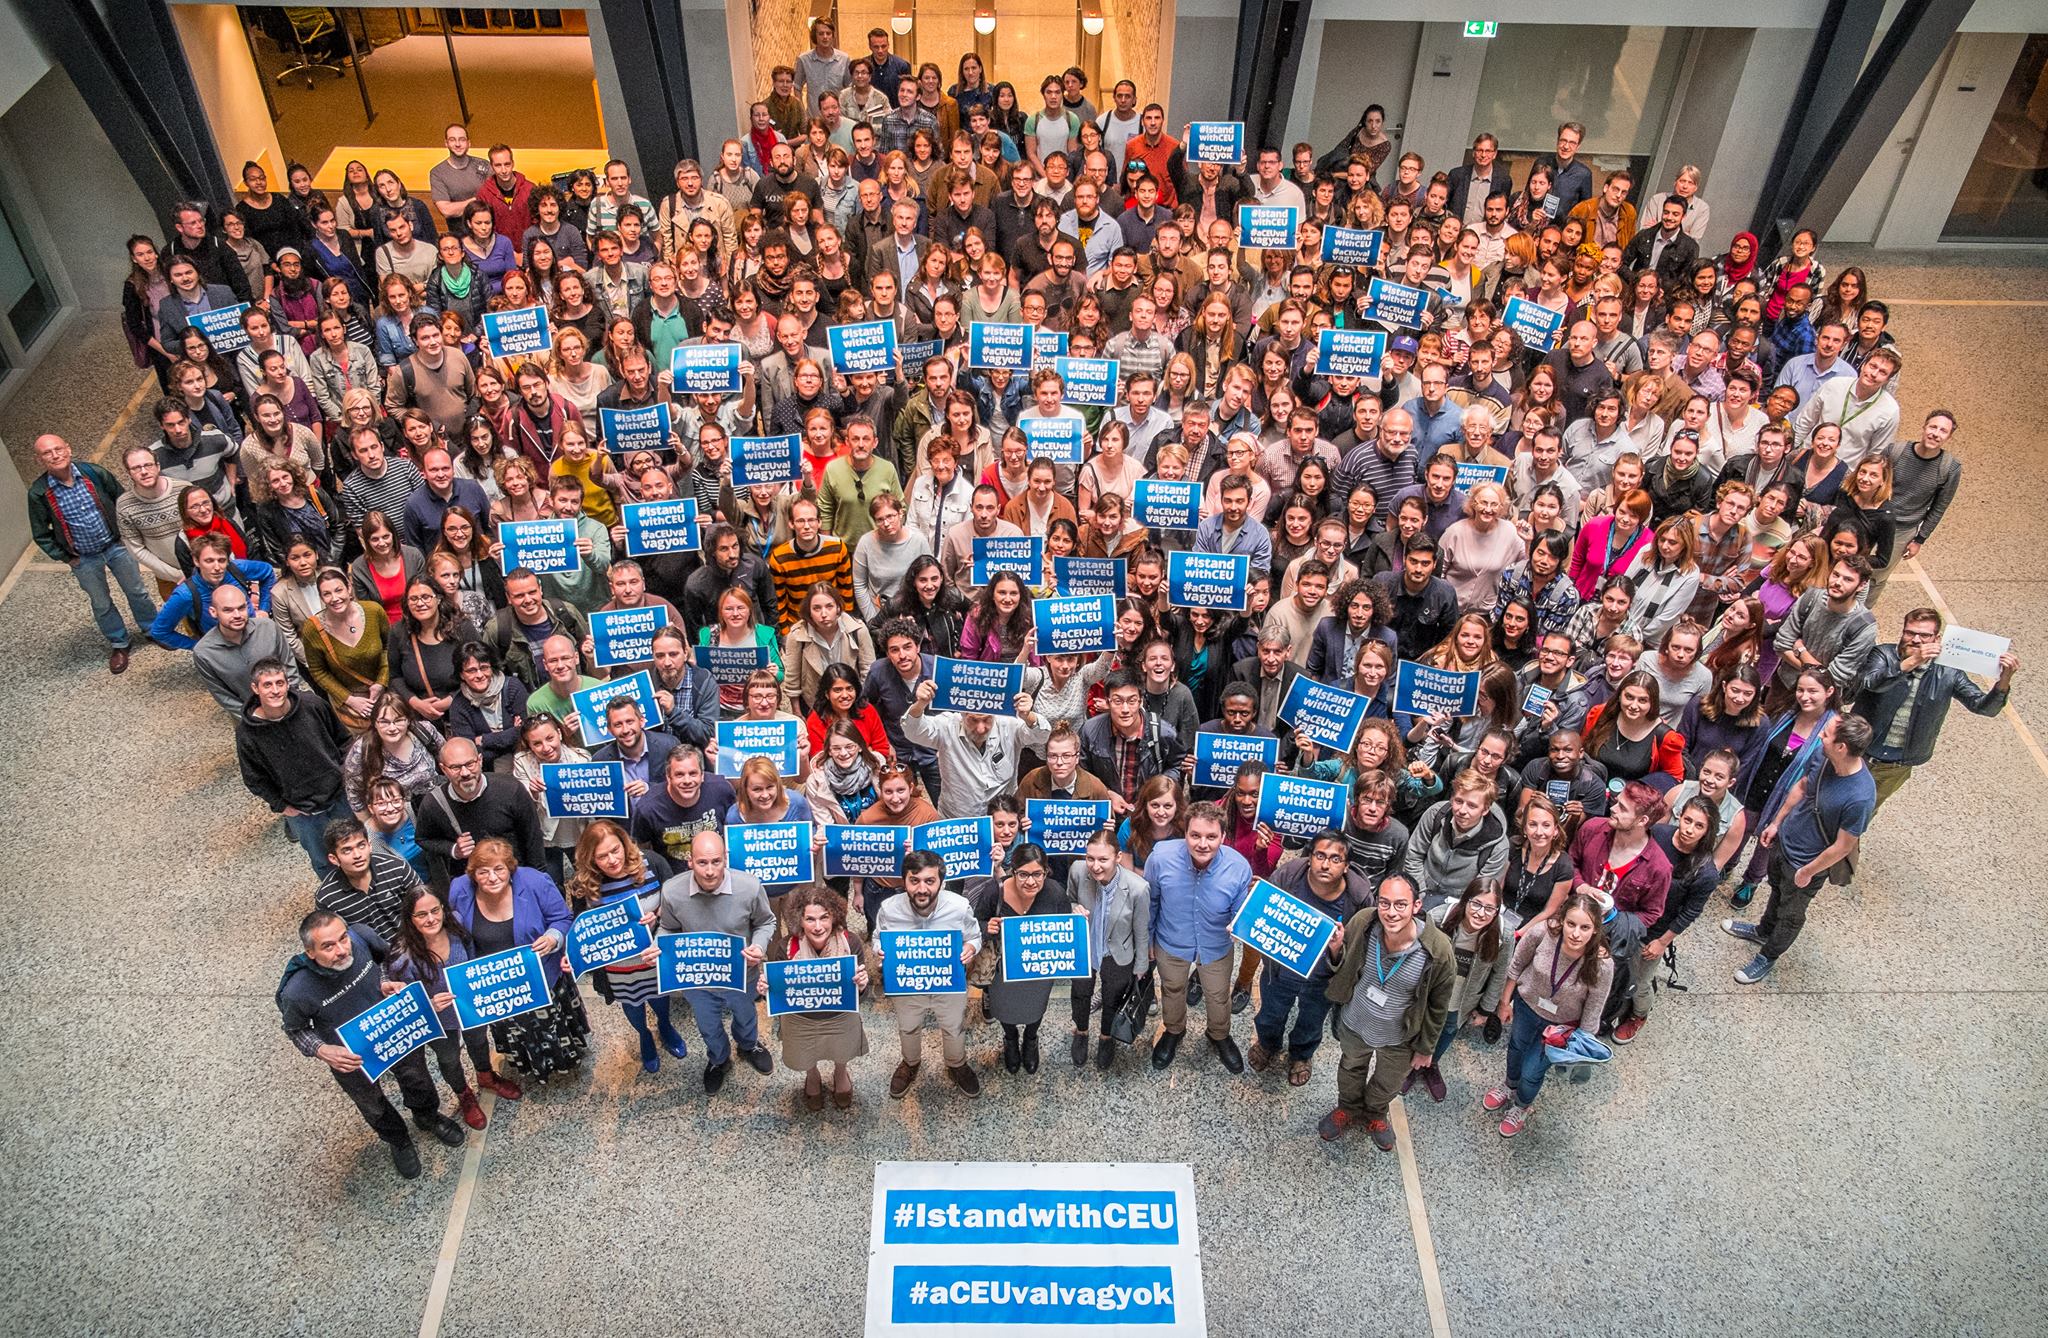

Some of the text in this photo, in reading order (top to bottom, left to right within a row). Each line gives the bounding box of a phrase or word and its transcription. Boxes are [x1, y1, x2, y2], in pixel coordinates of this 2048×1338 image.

[1199, 125, 1235, 134] #Istand
[1199, 133, 1234, 142] withCEU
[1198, 143, 1234, 152] #aCEUval
[1251, 209, 1289, 218] #Istand
[1251, 217, 1288, 226] withCEU
[1250, 228, 1287, 237] #aCEUval
[1335, 231, 1373, 241] #Istand
[1334, 239, 1372, 248] withCEU
[1332, 248, 1370, 257] #aCEUval
[1381, 285, 1420, 300] #Istand
[1380, 294, 1417, 307] withCEU
[1377, 302, 1414, 317] #aCEUval
[1518, 303, 1554, 322] #Istand
[496, 310, 537, 325] #Istand
[1516, 312, 1551, 329] withCEU
[498, 320, 538, 333] withCEU
[841, 324, 884, 339] #Istand
[983, 326, 1024, 337] #Istand
[500, 331, 540, 344] #aCEUval
[843, 335, 884, 348] withCEU
[983, 335, 1023, 345] withCEU
[1333, 334, 1376, 345] #Istand
[685, 347, 729, 358] #Istand
[844, 347, 886, 360] #aCEUval
[982, 346, 1022, 357] #aCEUval
[1332, 343, 1374, 354] withCEU
[685, 357, 729, 367] withCEU
[1329, 354, 1371, 365] #aCEUval
[1068, 361, 1109, 372] #Istand
[685, 370, 729, 379] #aCEUval
[1067, 370, 1108, 381] withCEU
[1066, 381, 1107, 393] #aCEUval
[614, 408, 658, 422] #Istand
[616, 419, 659, 430] withCEU
[1031, 419, 1073, 430] #Istand
[617, 431, 661, 441] #aCEUval
[1031, 429, 1072, 438] withCEU
[743, 438, 789, 451] #Istand
[1031, 440, 1072, 451] #aCEUval
[744, 449, 789, 460] withCEU
[744, 461, 790, 472] #aCEUval
[1147, 484, 1191, 495] #Istand
[1146, 494, 1190, 505] withCEU
[638, 502, 685, 517] #Istand
[1145, 505, 1189, 517] #aCEUval
[639, 514, 685, 527] withCEU
[515, 522, 564, 536] #Istand
[640, 527, 687, 540] #aCEUval
[516, 534, 564, 546] withCEU
[986, 539, 1031, 549] #Istand
[517, 548, 566, 560] #aCEUval
[986, 549, 1031, 559] withCEU
[986, 561, 1031, 572] #aCEUval
[1068, 561, 1113, 569] #Istand
[1184, 557, 1236, 570] #Istand
[1068, 568, 1114, 577] withCEU
[1184, 568, 1234, 581] withCEU
[1067, 578, 1115, 588] #aCEUval
[1183, 581, 1233, 595] #aCEUval
[1049, 598, 1102, 614] #Istand
[605, 610, 654, 626] #Istand
[1050, 611, 1102, 625] withCEU
[607, 622, 655, 636] withCEU
[1051, 626, 1102, 639] #aCEUval
[952, 664, 1009, 678] #Istand
[1415, 668, 1466, 685] #Istand
[951, 675, 1007, 688] withCEU
[1414, 679, 1464, 693] withCEU
[949, 686, 1005, 702] #aCEUval
[1308, 686, 1356, 708] #Istand
[1412, 690, 1463, 705] #aCEUval
[1303, 697, 1350, 717] withCEU
[1296, 708, 1344, 732] #aCEUval
[733, 724, 785, 737] #Istand
[733, 736, 785, 747] withCEU
[557, 765, 610, 779] #Istand
[559, 777, 611, 789] withCEU
[1280, 781, 1335, 799] #Istand
[562, 791, 614, 803] #aCEUval
[1278, 795, 1332, 810] withCEU
[1275, 808, 1330, 825] #aCEUval
[743, 825, 797, 841] #Istand
[840, 831, 896, 842] #Istand
[744, 839, 797, 852] withCEU
[841, 841, 895, 852] withCEU
[744, 855, 798, 868] #aCEUval
[841, 854, 894, 865] #aCEUval
[1269, 893, 1323, 929] #Istand
[574, 904, 626, 933] #Istand
[1263, 905, 1315, 938] withCEU
[576, 915, 628, 942] withCEU
[1019, 918, 1074, 933] #Istand
[580, 928, 634, 956] #aCEUval
[674, 936, 731, 947] #Istand
[895, 933, 952, 947] #Istand
[1020, 932, 1074, 945] withCEU
[1254, 917, 1307, 954] #aCEUval
[675, 947, 731, 958] withCEU
[896, 947, 952, 960] withCEU
[1021, 948, 1075, 961] #aCEUval
[465, 951, 523, 979] #Istand
[675, 962, 731, 973] #aCEUval
[784, 961, 841, 975] #Istand
[896, 964, 952, 976] #aCEUval
[469, 965, 526, 991] withCEU
[785, 973, 841, 985] withCEU
[473, 981, 531, 1007] #aCEUval
[785, 986, 842, 998] #aCEUval
[359, 990, 414, 1032] #Istand
[365, 1001, 419, 1042] withCEU
[373, 1014, 427, 1055] #aCEUval
[893, 1202, 1175, 1229] #IstandwithCEU
[909, 1281, 1174, 1310] #aCEUvalvagyok
